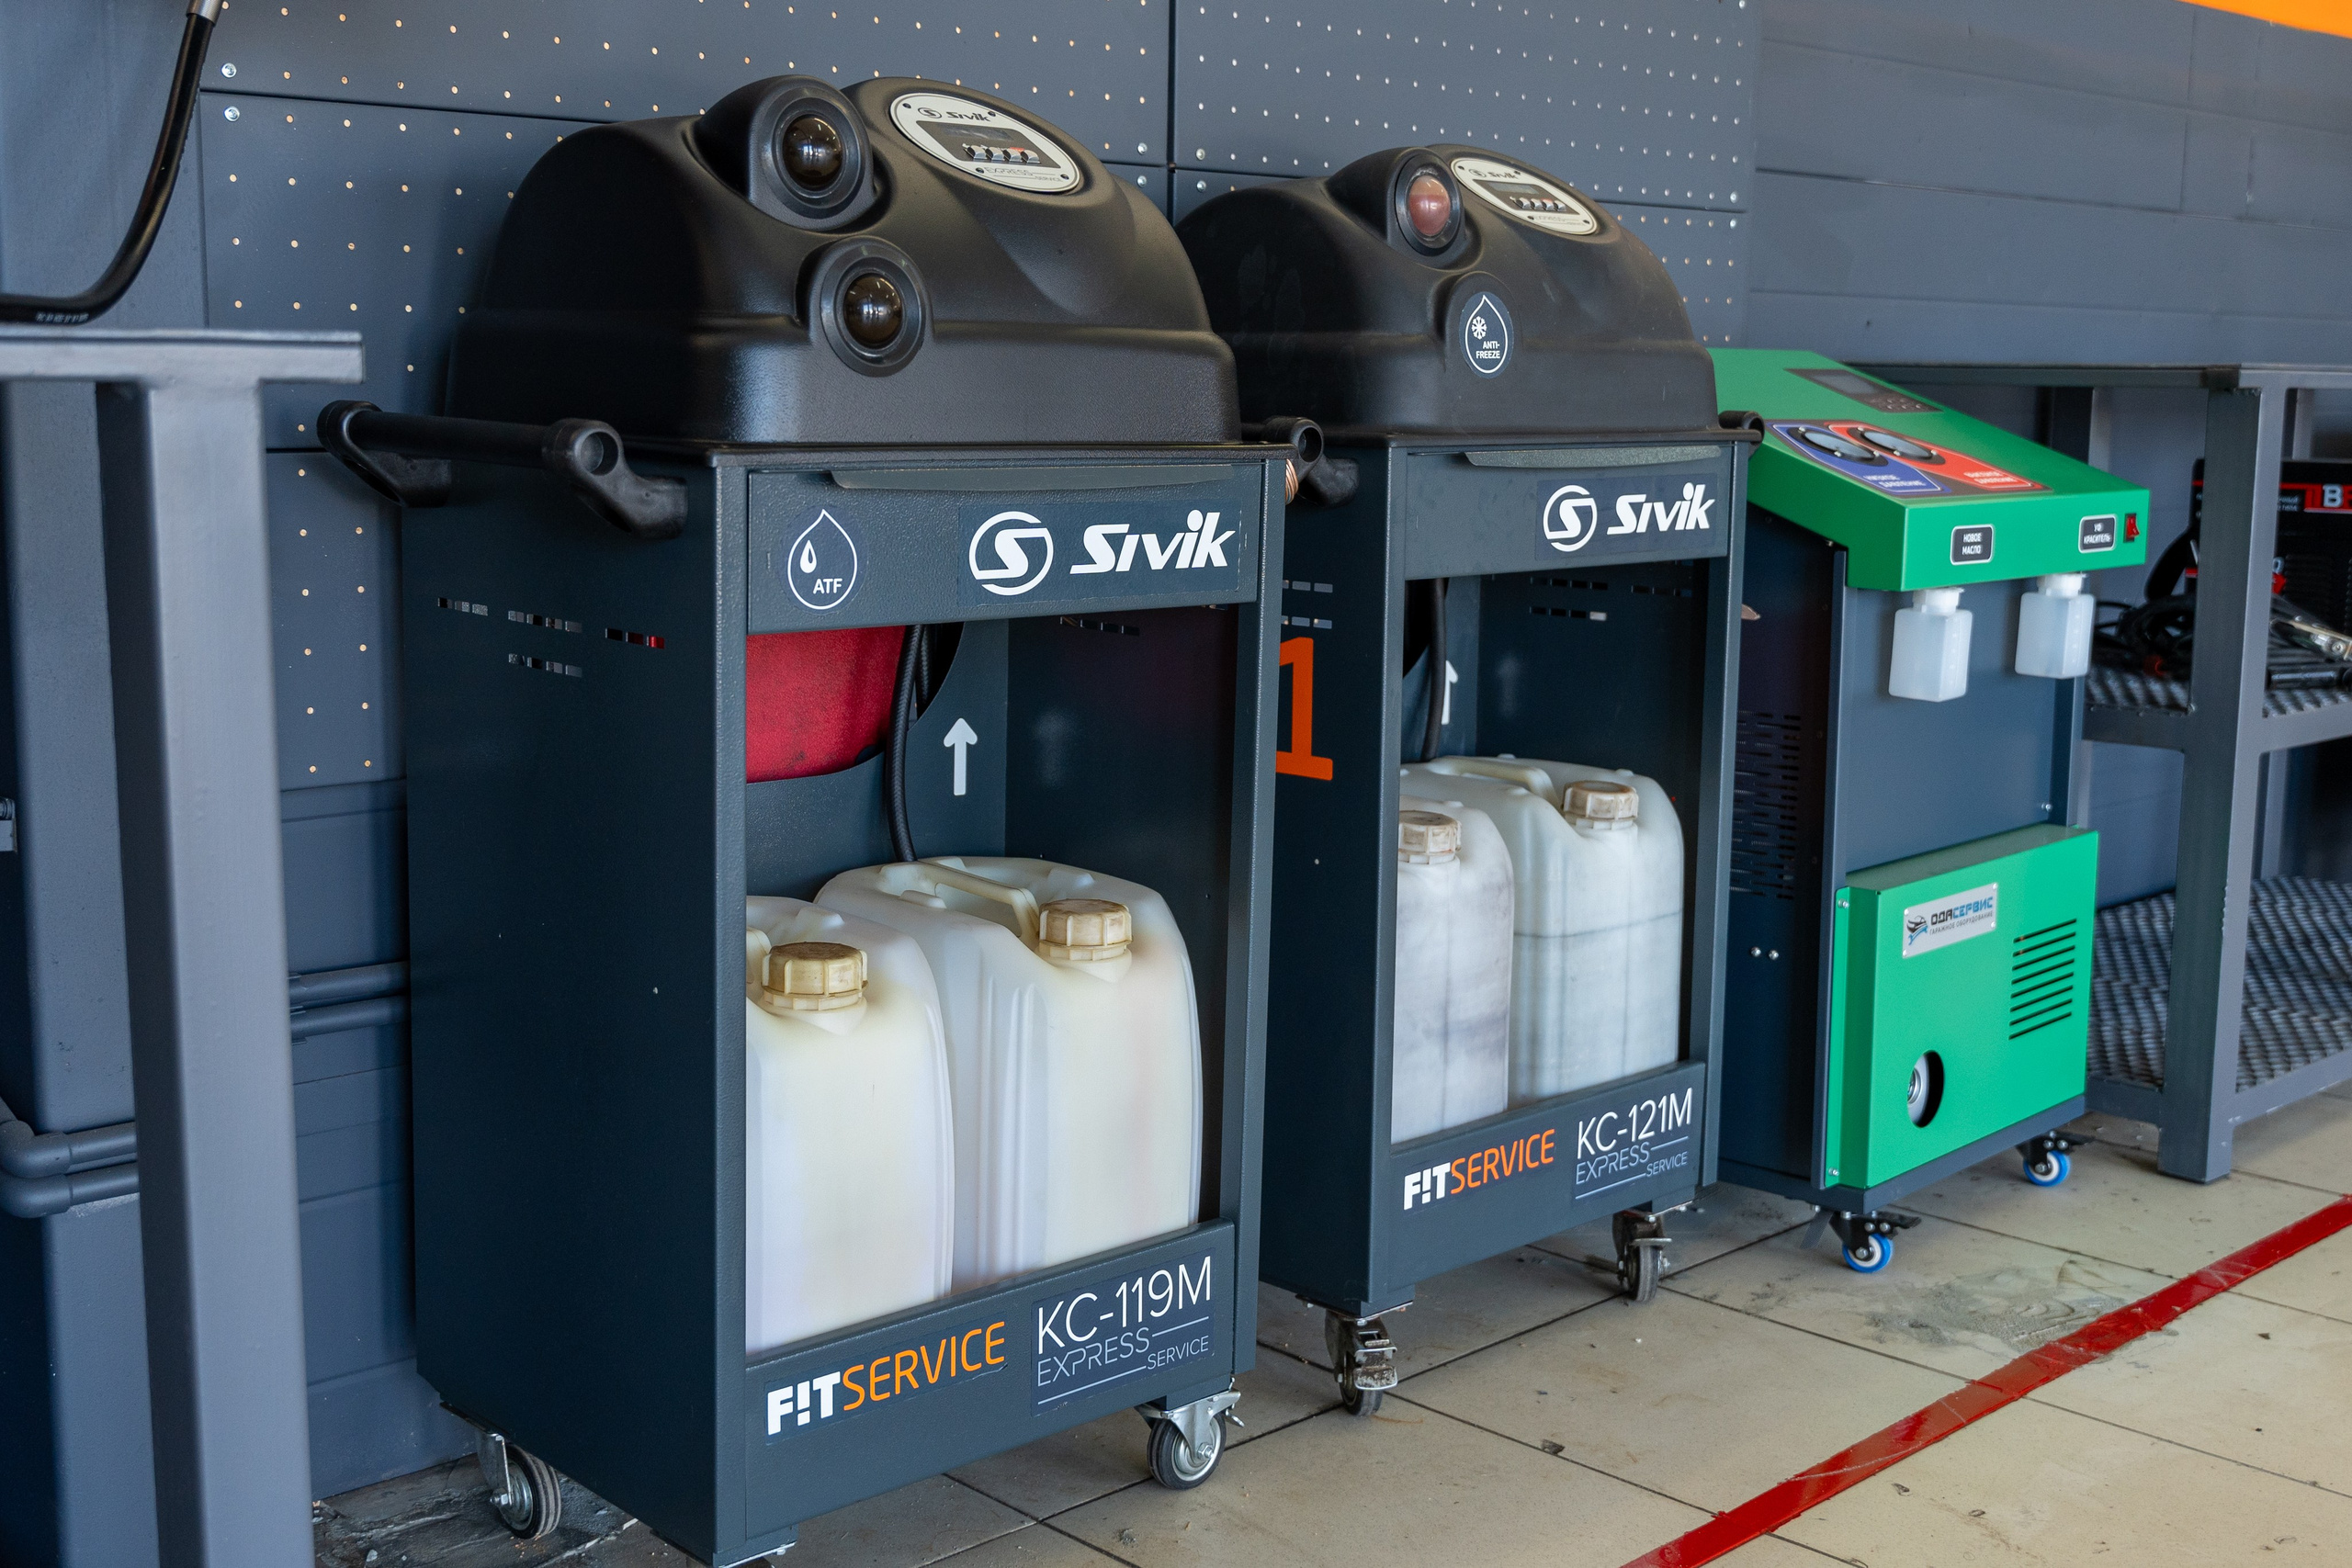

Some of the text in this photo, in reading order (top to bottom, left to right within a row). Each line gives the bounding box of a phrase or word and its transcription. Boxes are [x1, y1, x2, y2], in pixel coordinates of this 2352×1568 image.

[1483, 341, 1500, 349] ANTI-
[1476, 350, 1500, 359] FREEZE
[1962, 545, 1982, 555] МАСЛО
[812, 578, 842, 594] ATF
[1929, 923, 1955, 935] ГАРАЖНОЕ
[1576, 1141, 1650, 1185] EXPRESS
[1645, 1151, 1689, 1178] SERVICE
[1037, 1326, 1150, 1387] EXPRESS
[1147, 1335, 1209, 1370] SERVICE
